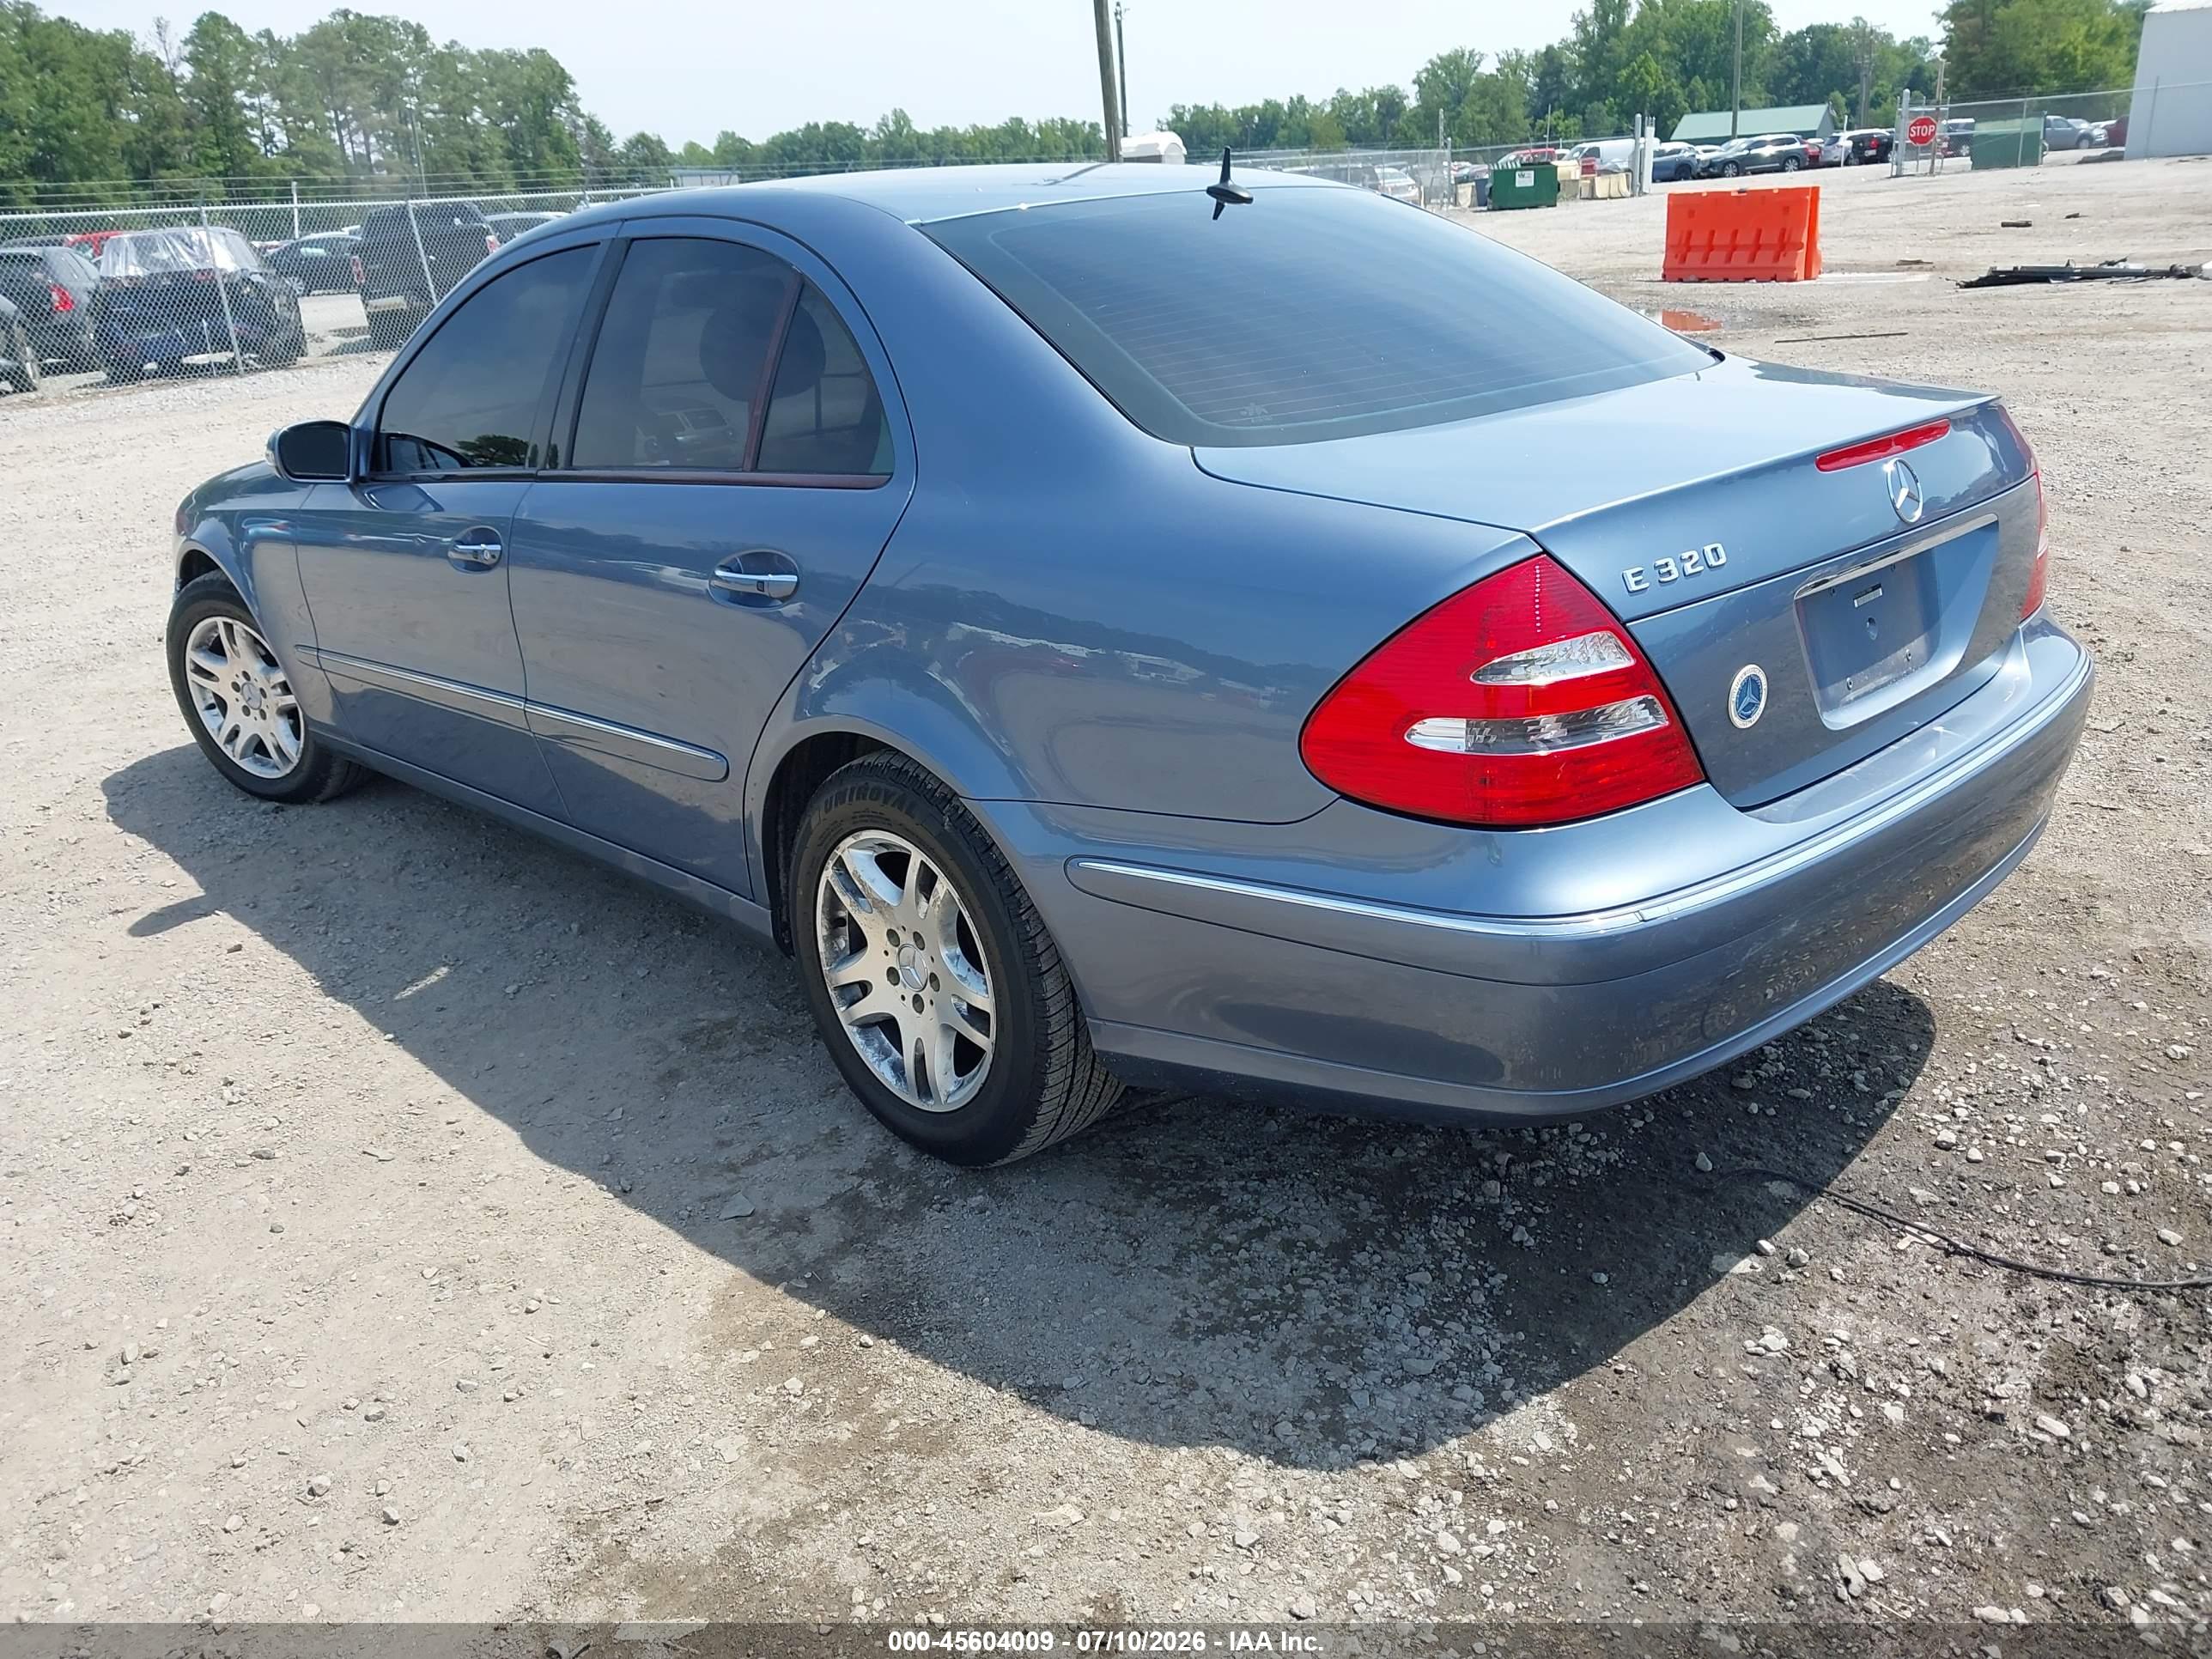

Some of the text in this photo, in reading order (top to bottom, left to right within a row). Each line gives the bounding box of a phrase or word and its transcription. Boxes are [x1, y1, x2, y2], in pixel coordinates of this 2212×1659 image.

[1909, 125, 1936, 137] STOP
[1622, 543, 1727, 592] E 320
